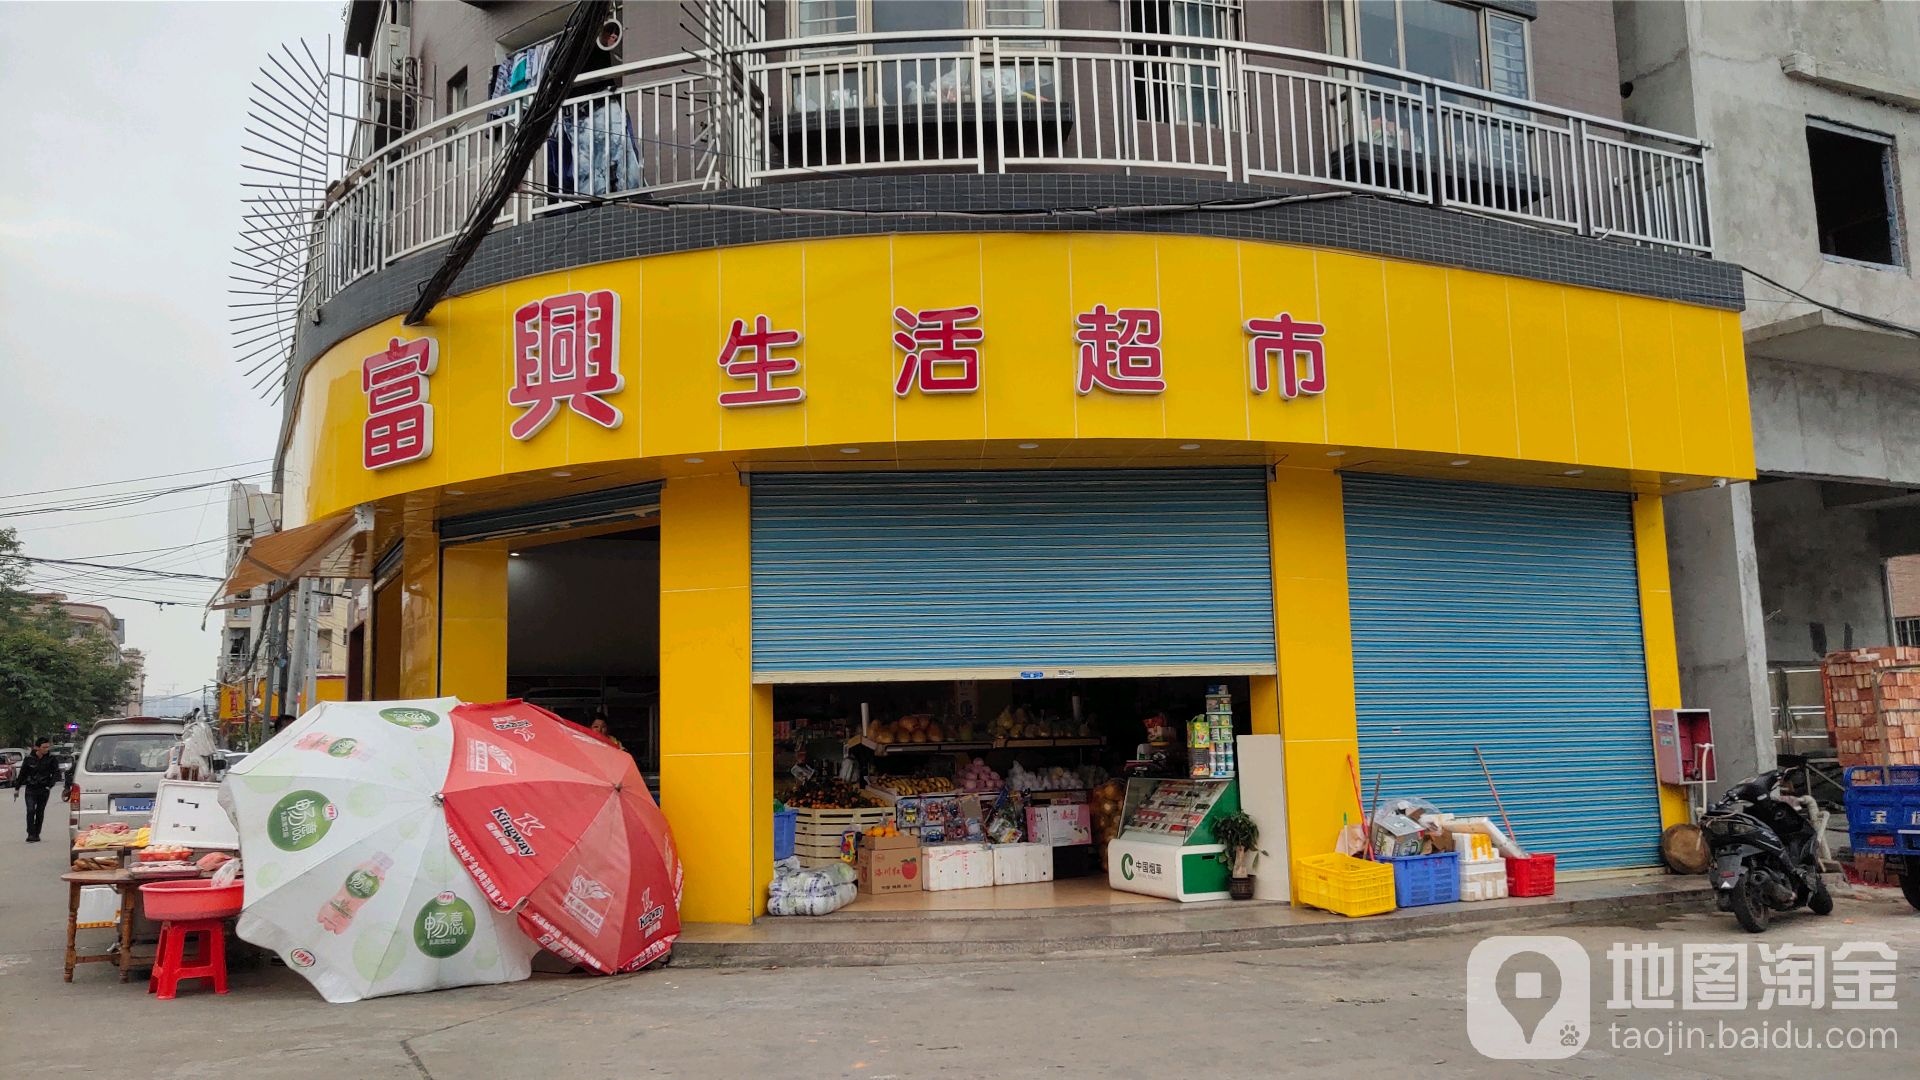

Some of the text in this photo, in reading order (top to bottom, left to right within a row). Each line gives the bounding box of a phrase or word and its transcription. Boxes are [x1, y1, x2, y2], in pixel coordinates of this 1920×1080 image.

[362, 288, 1328, 471] 富興生活超市
[492, 807, 534, 856] Kingway
[1136, 861, 1162, 874] 中国烟草
